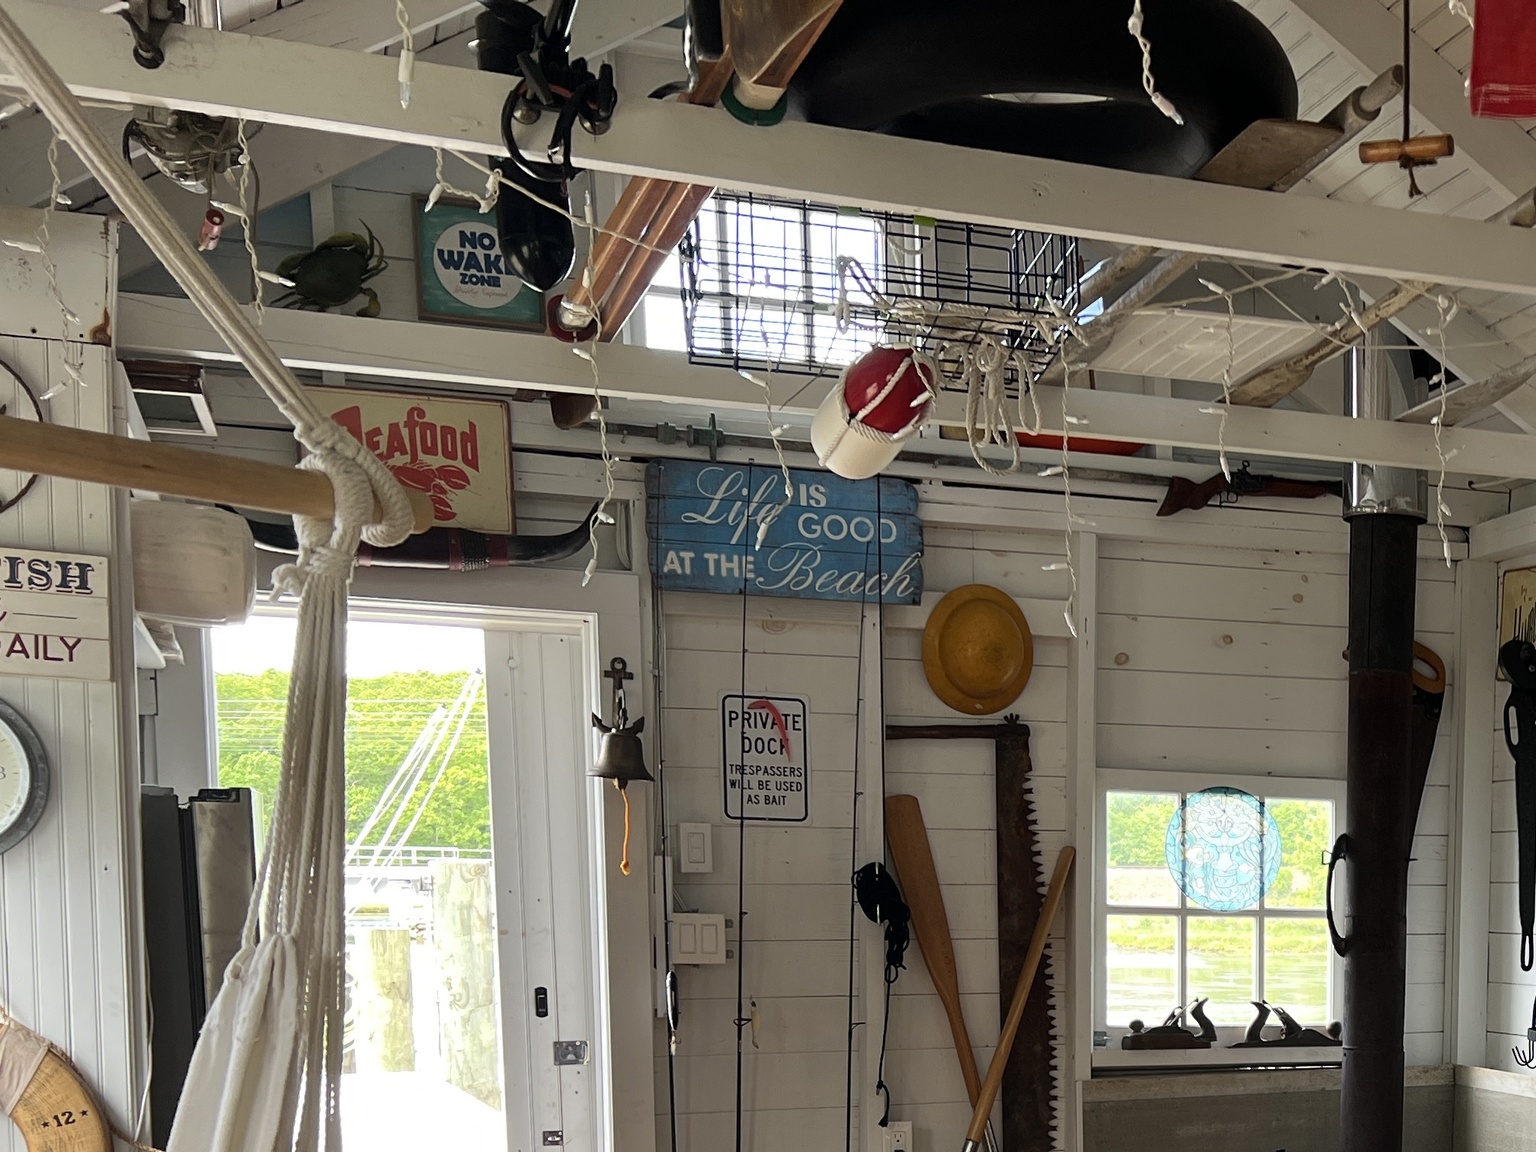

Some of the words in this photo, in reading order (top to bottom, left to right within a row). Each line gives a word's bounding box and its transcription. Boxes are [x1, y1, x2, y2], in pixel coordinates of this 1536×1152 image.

[459, 230, 496, 251] NO
[460, 273, 501, 288] ZONE
[681, 467, 782, 544] Life
[800, 483, 827, 508] IS
[798, 512, 897, 544] GOOD
[0, 555, 96, 596] ISH
[663, 551, 695, 576] AT
[704, 553, 756, 579] THE
[755, 542, 921, 598] Beach
[0, 633, 82, 662] AILY
[728, 710, 802, 732] PRIVATE
[741, 736, 790, 756] DOCK
[729, 764, 803, 778] TRESPASSERS
[729, 778, 754, 790] WILL
[758, 780, 772, 791] BE
[775, 781, 803, 792] USED
[747, 794, 760, 805] AS
[764, 795, 787, 806] BAIT
[52, 1110, 76, 1127] 12
